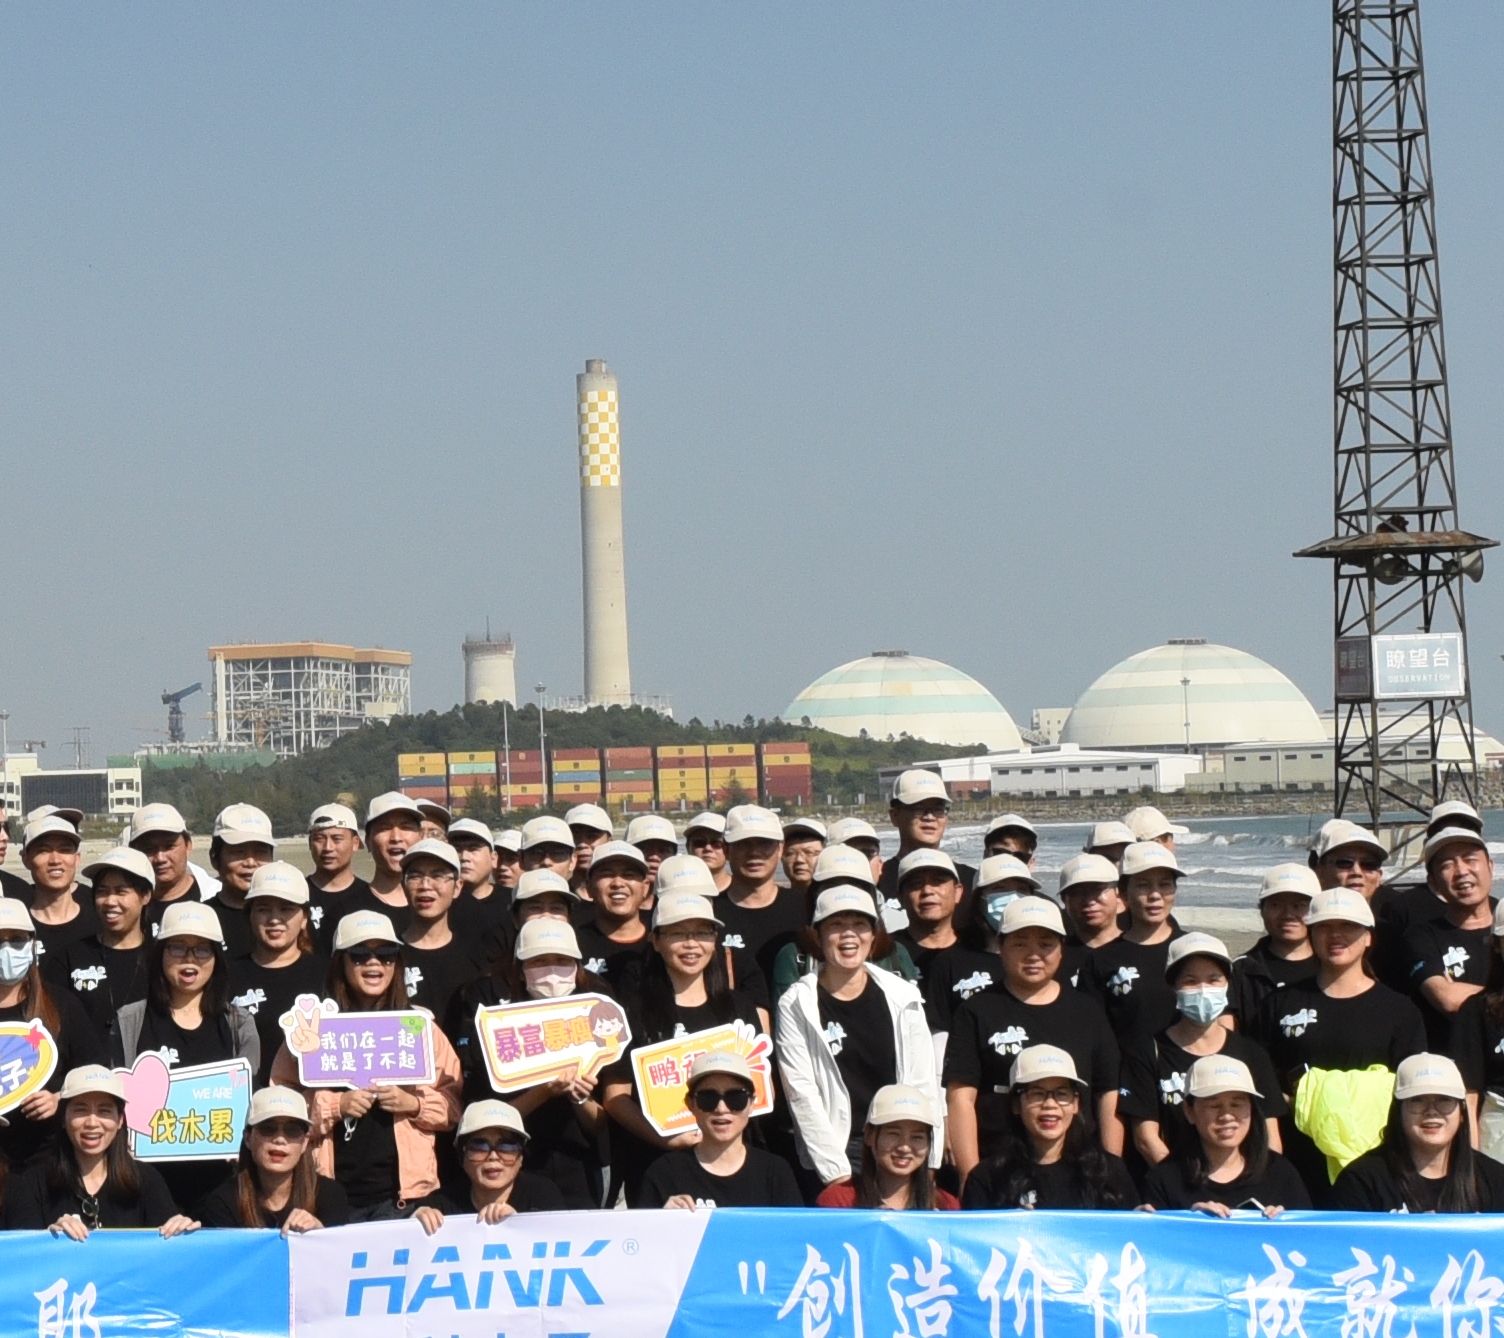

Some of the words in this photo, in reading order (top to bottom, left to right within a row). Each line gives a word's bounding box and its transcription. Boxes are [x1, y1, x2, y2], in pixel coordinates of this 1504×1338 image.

[321, 1029, 416, 1052] 我们在一起
[493, 1015, 594, 1063] 暴富暴瘦
[321, 1051, 417, 1073] 就是了不起
[192, 1087, 210, 1100] WE
[211, 1086, 234, 1099] ARE
[149, 1107, 234, 1145] 伐木累
[345, 1239, 612, 1317] HANK
